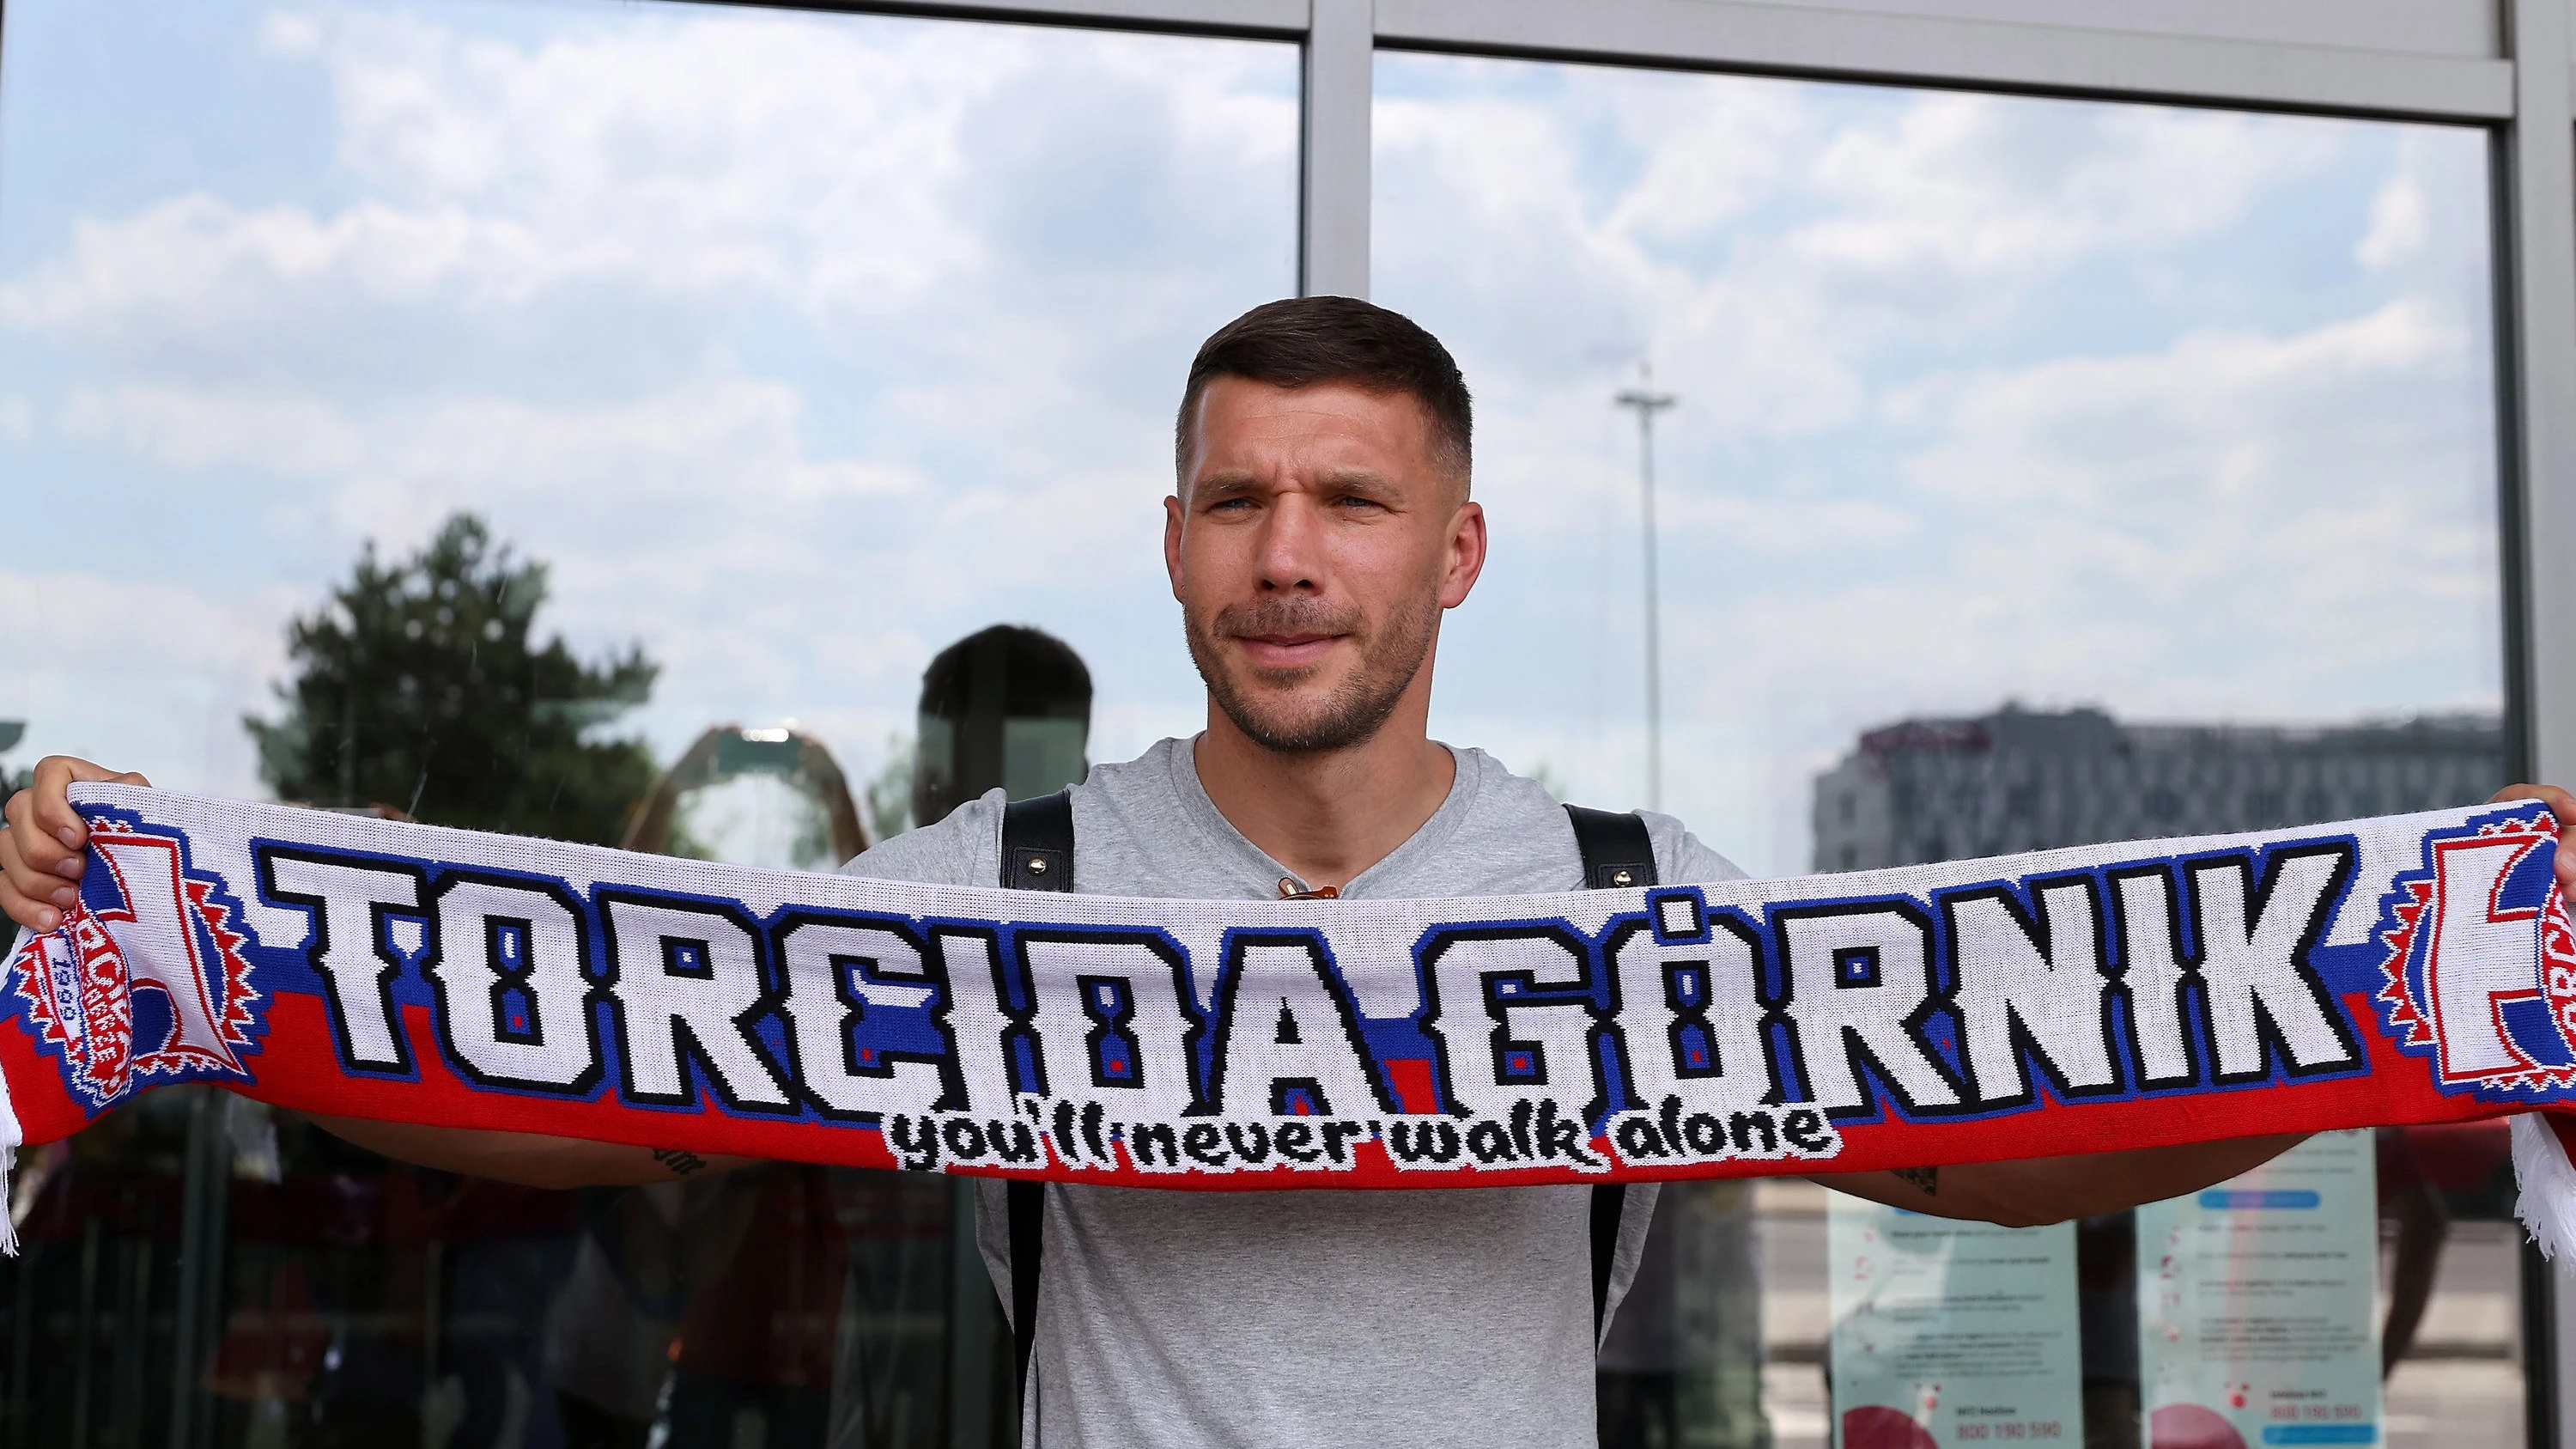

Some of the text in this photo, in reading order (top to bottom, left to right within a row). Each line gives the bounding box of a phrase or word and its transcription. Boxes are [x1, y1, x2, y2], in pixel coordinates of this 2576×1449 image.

[52, 957, 78, 1022] 1999
[258, 844, 1401, 1127] TORCIDA
[890, 1093, 1833, 1170] you'll never walk alone
